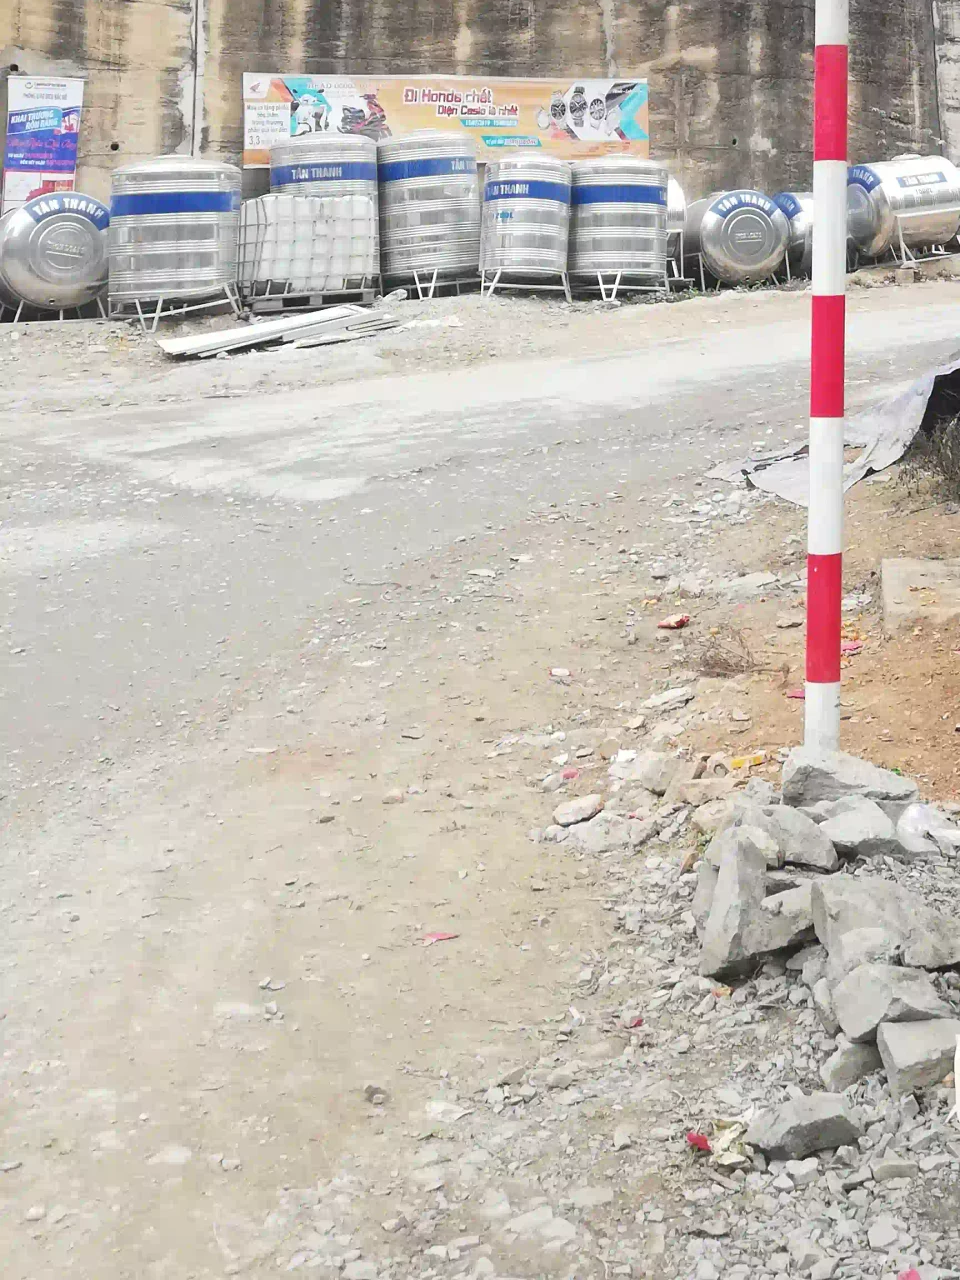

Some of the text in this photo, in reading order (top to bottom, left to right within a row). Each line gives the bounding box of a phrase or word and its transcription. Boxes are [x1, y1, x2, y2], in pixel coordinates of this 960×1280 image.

[421, 88, 462, 103] Honda
[311, 167, 342, 178] THANH
[500, 183, 530, 195] THANH
[62, 197, 105, 219] THANH
